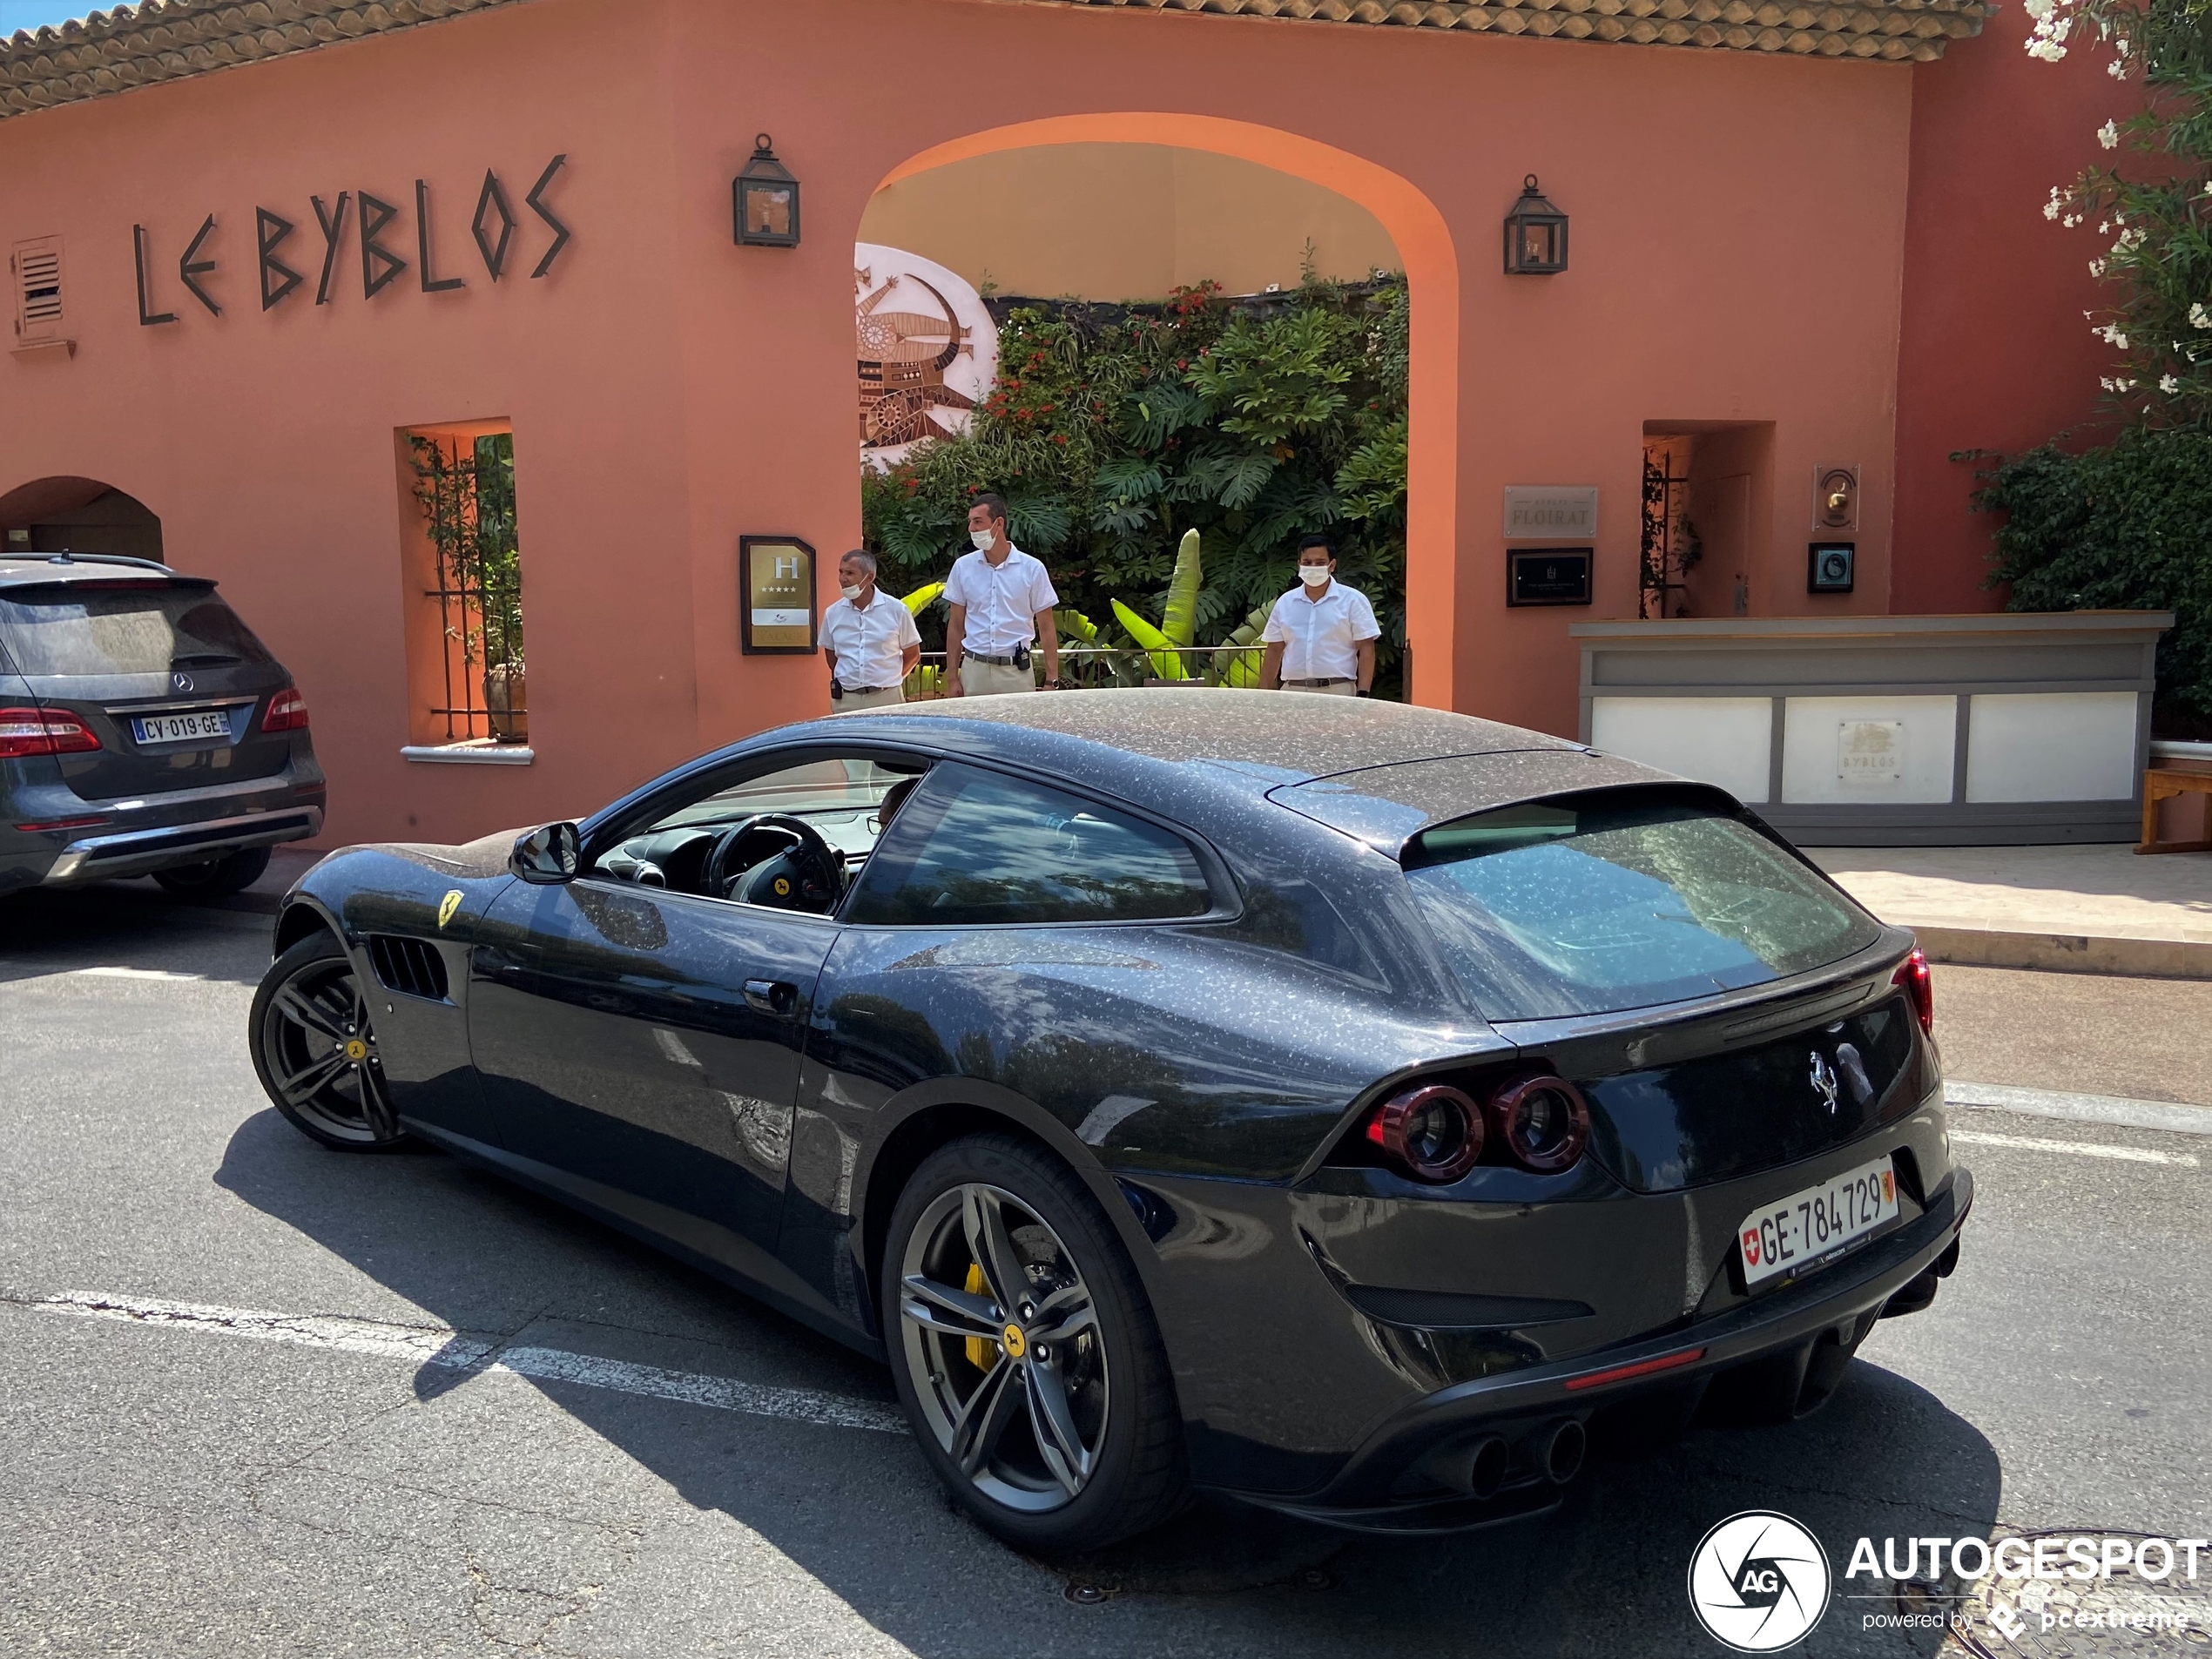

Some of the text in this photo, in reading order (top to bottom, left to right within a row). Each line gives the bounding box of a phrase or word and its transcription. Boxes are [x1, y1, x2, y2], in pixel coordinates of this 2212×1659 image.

[133, 153, 570, 326] LE BYBLOS
[1514, 509, 1588, 525] FLOIRAT
[772, 556, 799, 579] H
[145, 715, 220, 738] CV-019-GE
[1844, 757, 1895, 767] BYBLOS
